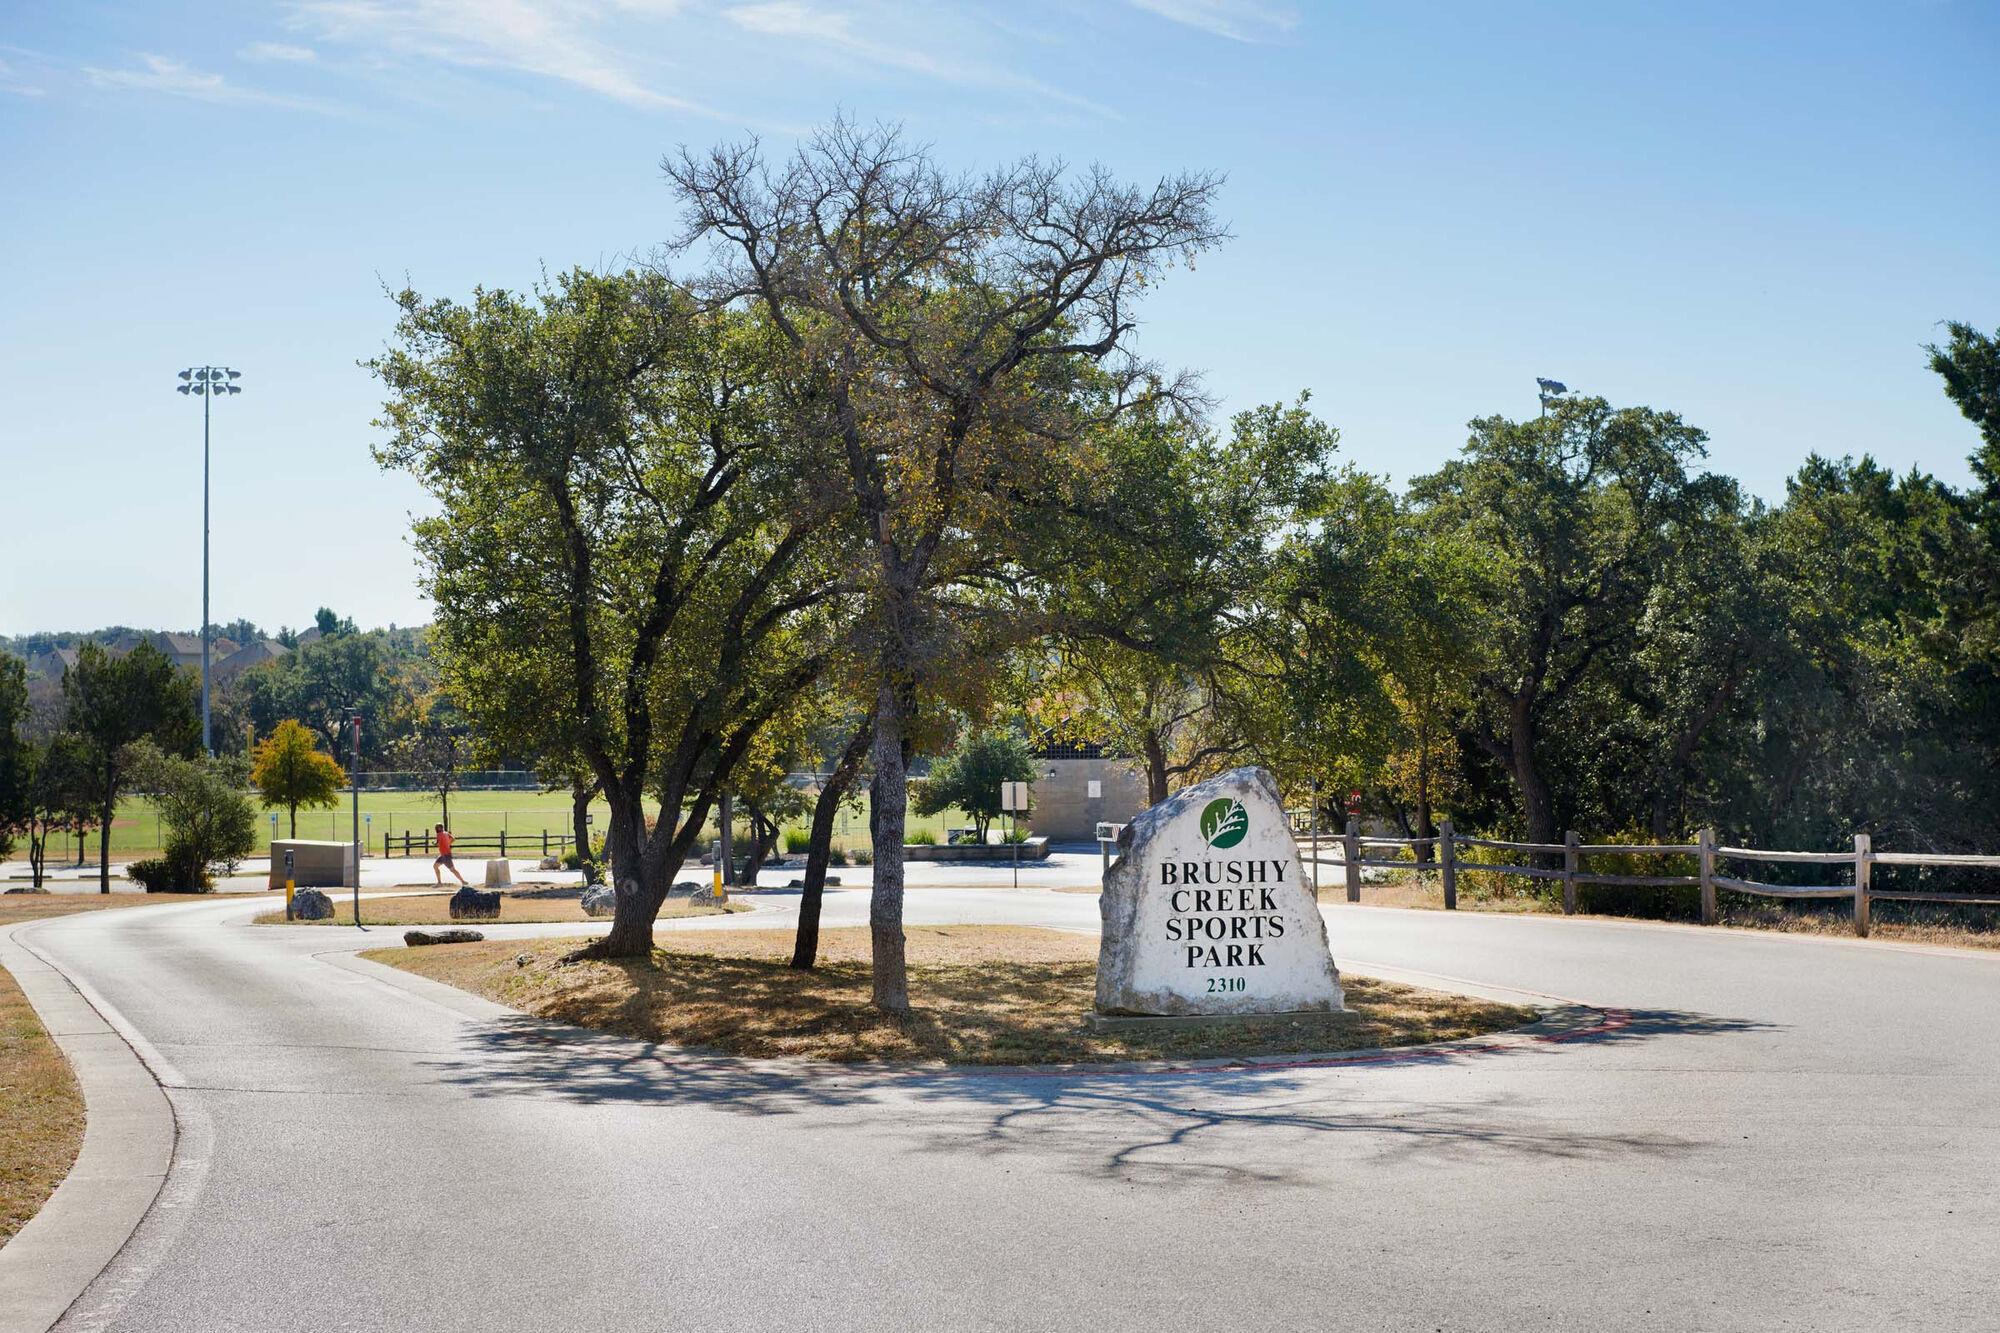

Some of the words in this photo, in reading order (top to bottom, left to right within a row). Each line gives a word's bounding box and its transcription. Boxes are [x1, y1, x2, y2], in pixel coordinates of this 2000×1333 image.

[1160, 859, 1289, 885] BRUSHY
[1171, 887, 1278, 913] CREEK
[1165, 915, 1285, 941] SPORTS
[1186, 943, 1266, 968] PARK
[1207, 976, 1246, 993] 2310
